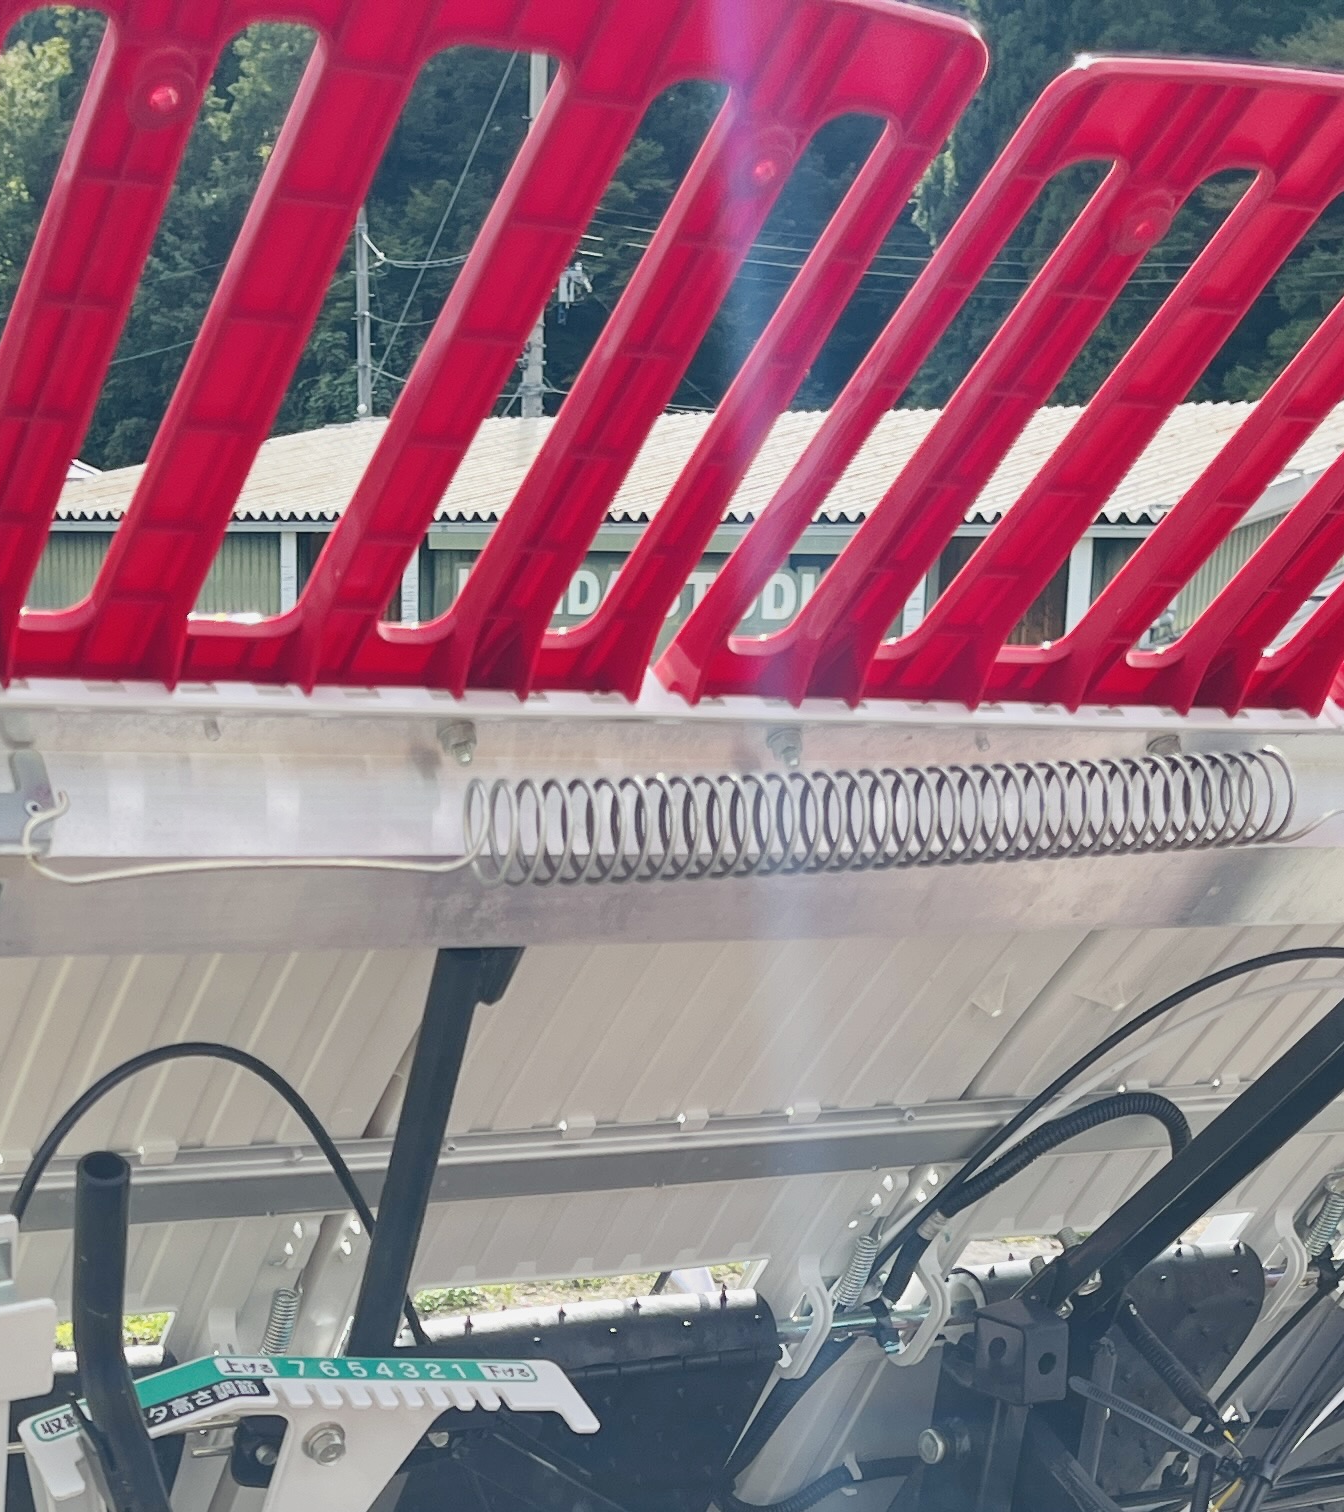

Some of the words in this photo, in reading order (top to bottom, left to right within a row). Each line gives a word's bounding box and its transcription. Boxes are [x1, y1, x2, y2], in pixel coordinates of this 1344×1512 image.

[224, 1359, 273, 1374] 上げる
[481, 1365, 530, 1379] 下げる
